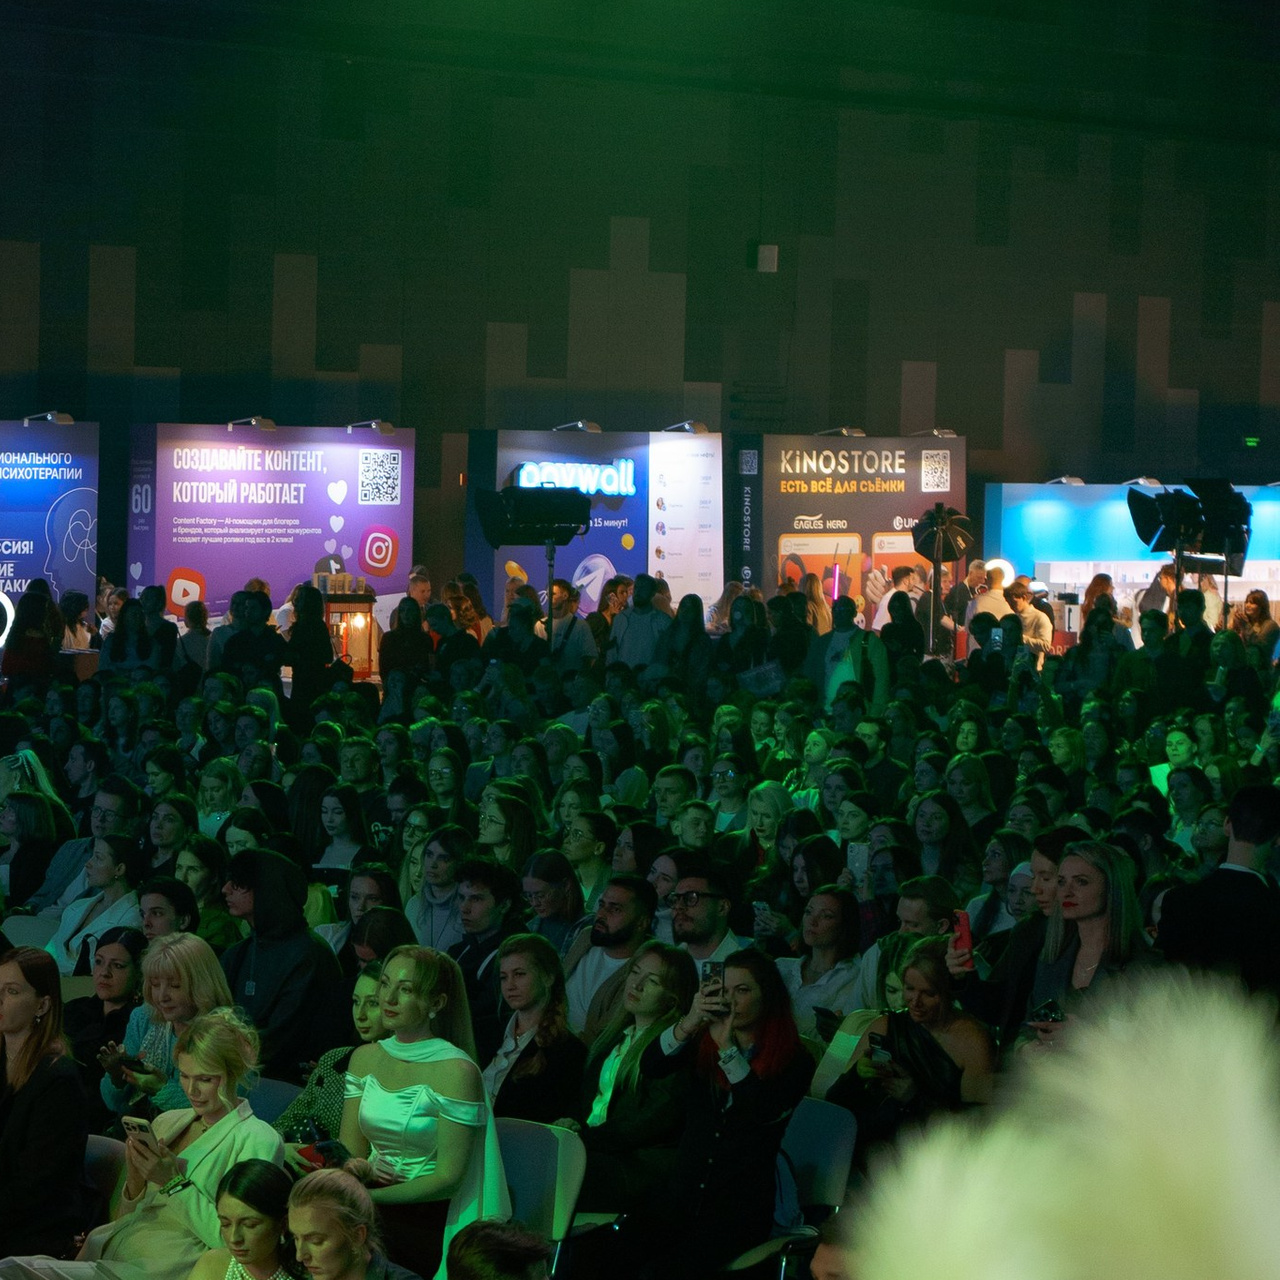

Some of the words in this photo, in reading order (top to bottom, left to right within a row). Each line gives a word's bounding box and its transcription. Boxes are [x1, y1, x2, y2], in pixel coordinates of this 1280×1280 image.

[173, 446, 262, 472] СОЗДАВАЙТЕ
[265, 449, 327, 474] КОНТЕНТ,
[173, 479, 237, 503] КОТОРЫЙ
[240, 483, 306, 504] РАБОТАЕТ
[780, 480, 808, 493] ЕСТЬ
[811, 477, 832, 493] ВСЁ
[834, 480, 857, 494] ДЛЯ
[860, 477, 905, 493] СЪЁМКИ
[132, 484, 151, 513] 60
[196, 517, 217, 525] Factory
[594, 518, 603, 527] 15
[604, 518, 628, 529] минут!
[743, 486, 751, 551] KINOSTORE
[826, 520, 847, 529] HERO
